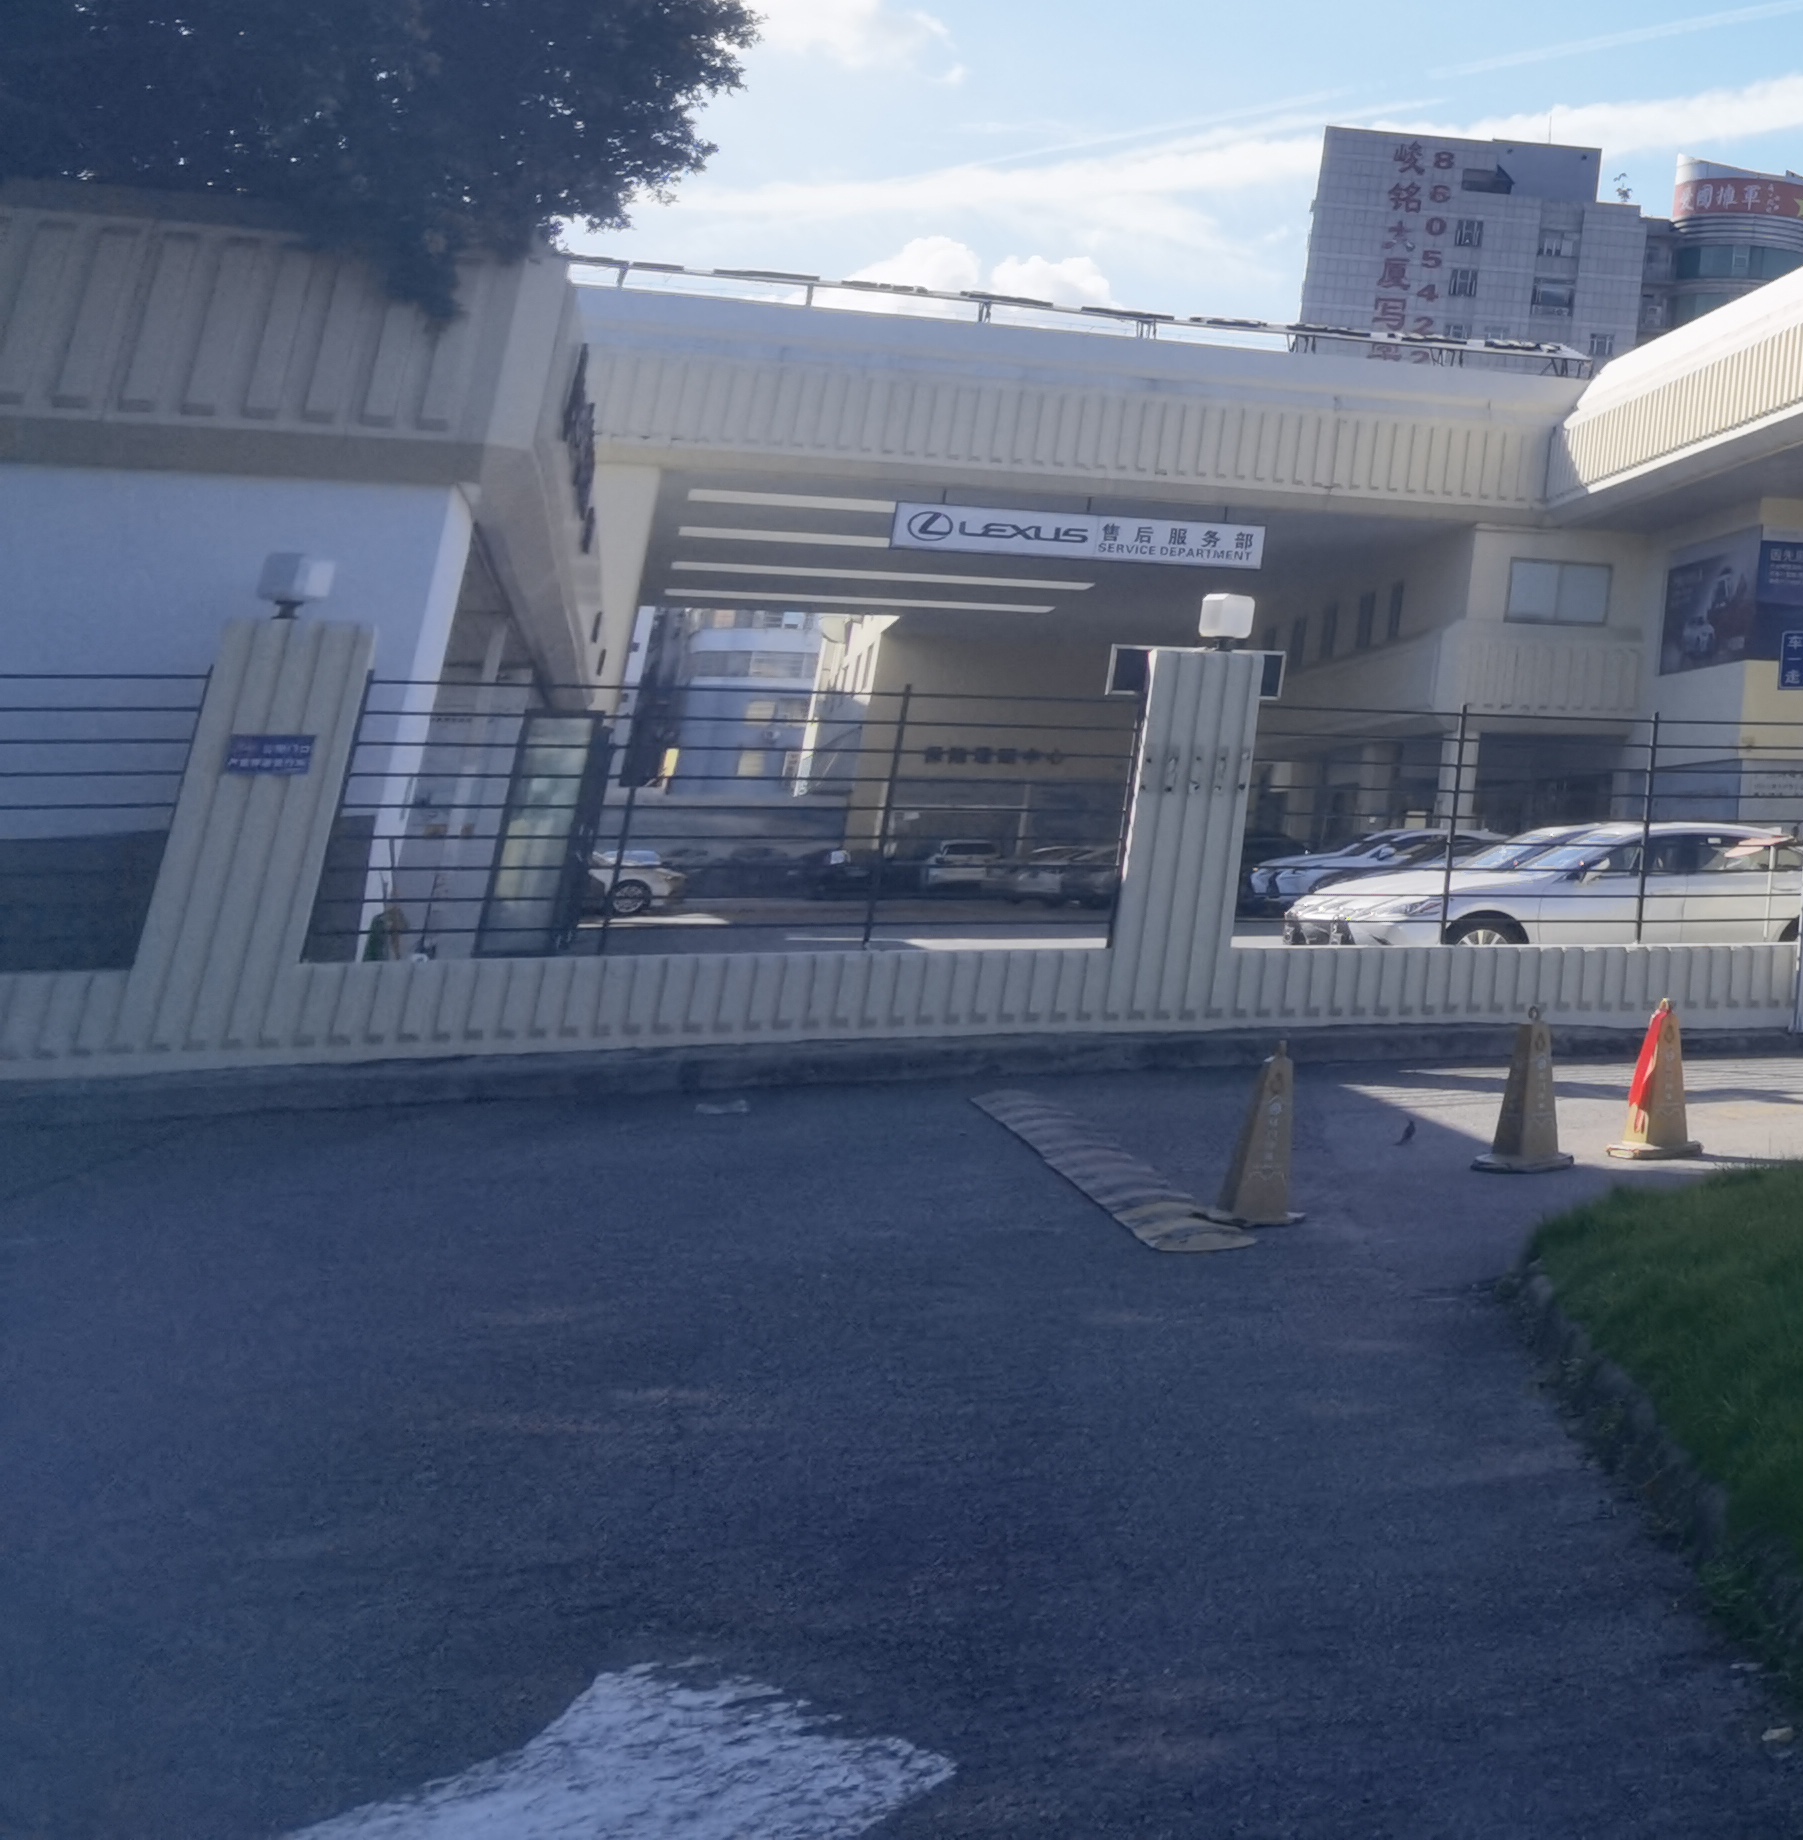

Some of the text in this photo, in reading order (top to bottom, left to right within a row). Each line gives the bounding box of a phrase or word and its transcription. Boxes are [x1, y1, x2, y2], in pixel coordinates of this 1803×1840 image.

[959, 520, 1089, 543] LEXUS
[1102, 522, 1254, 550] 售后服务部
[1098, 543, 1253, 562] SERVICE DEPARTMENT
